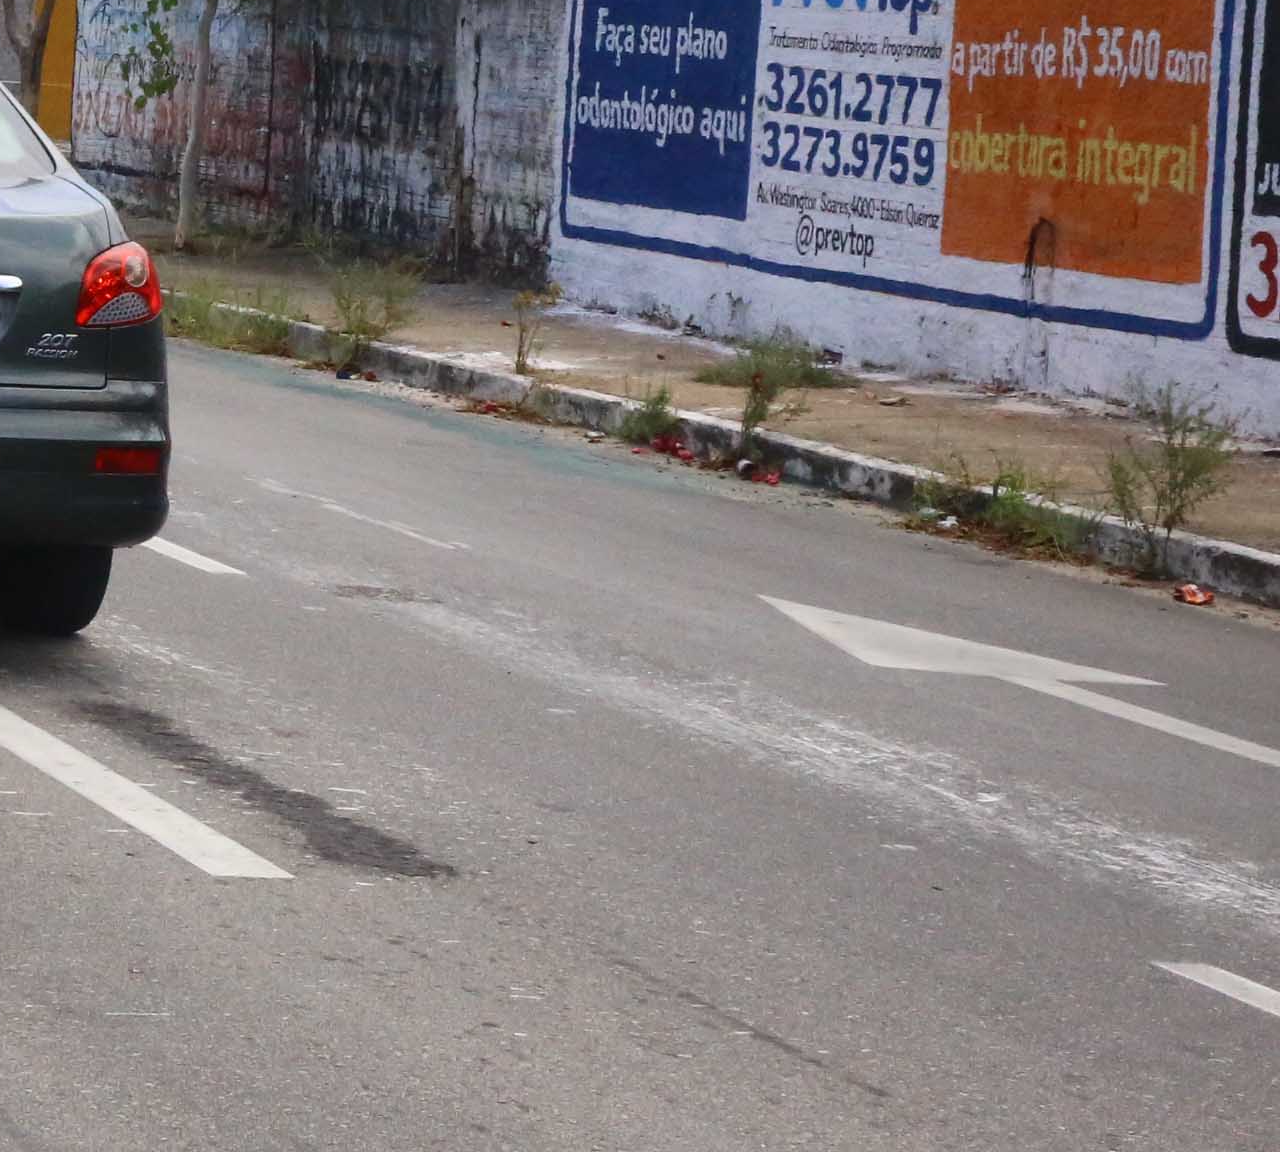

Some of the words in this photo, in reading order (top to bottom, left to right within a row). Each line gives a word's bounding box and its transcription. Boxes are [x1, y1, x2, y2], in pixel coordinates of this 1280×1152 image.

[595, 7, 635, 67] Faça
[639, 24, 672, 57] seu
[675, 11, 728, 74] plano
[951, 40, 965, 77] a
[968, 28, 1028, 94] partir
[1030, 26, 1057, 80] de
[1061, 15, 1091, 89] R$
[1093, 25, 1161, 88] 35,00
[1165, 48, 1209, 86] com
[577, 81, 695, 147] odontológico
[700, 95, 747, 156] aqui
[765, 61, 943, 127] 3261.2777
[761, 120, 936, 186] 3273.9759
[949, 113, 1067, 180] cobertura
[1076, 117, 1200, 205] integral
[795, 214, 875, 268] @prevtop
[37, 333, 79, 348] 207
